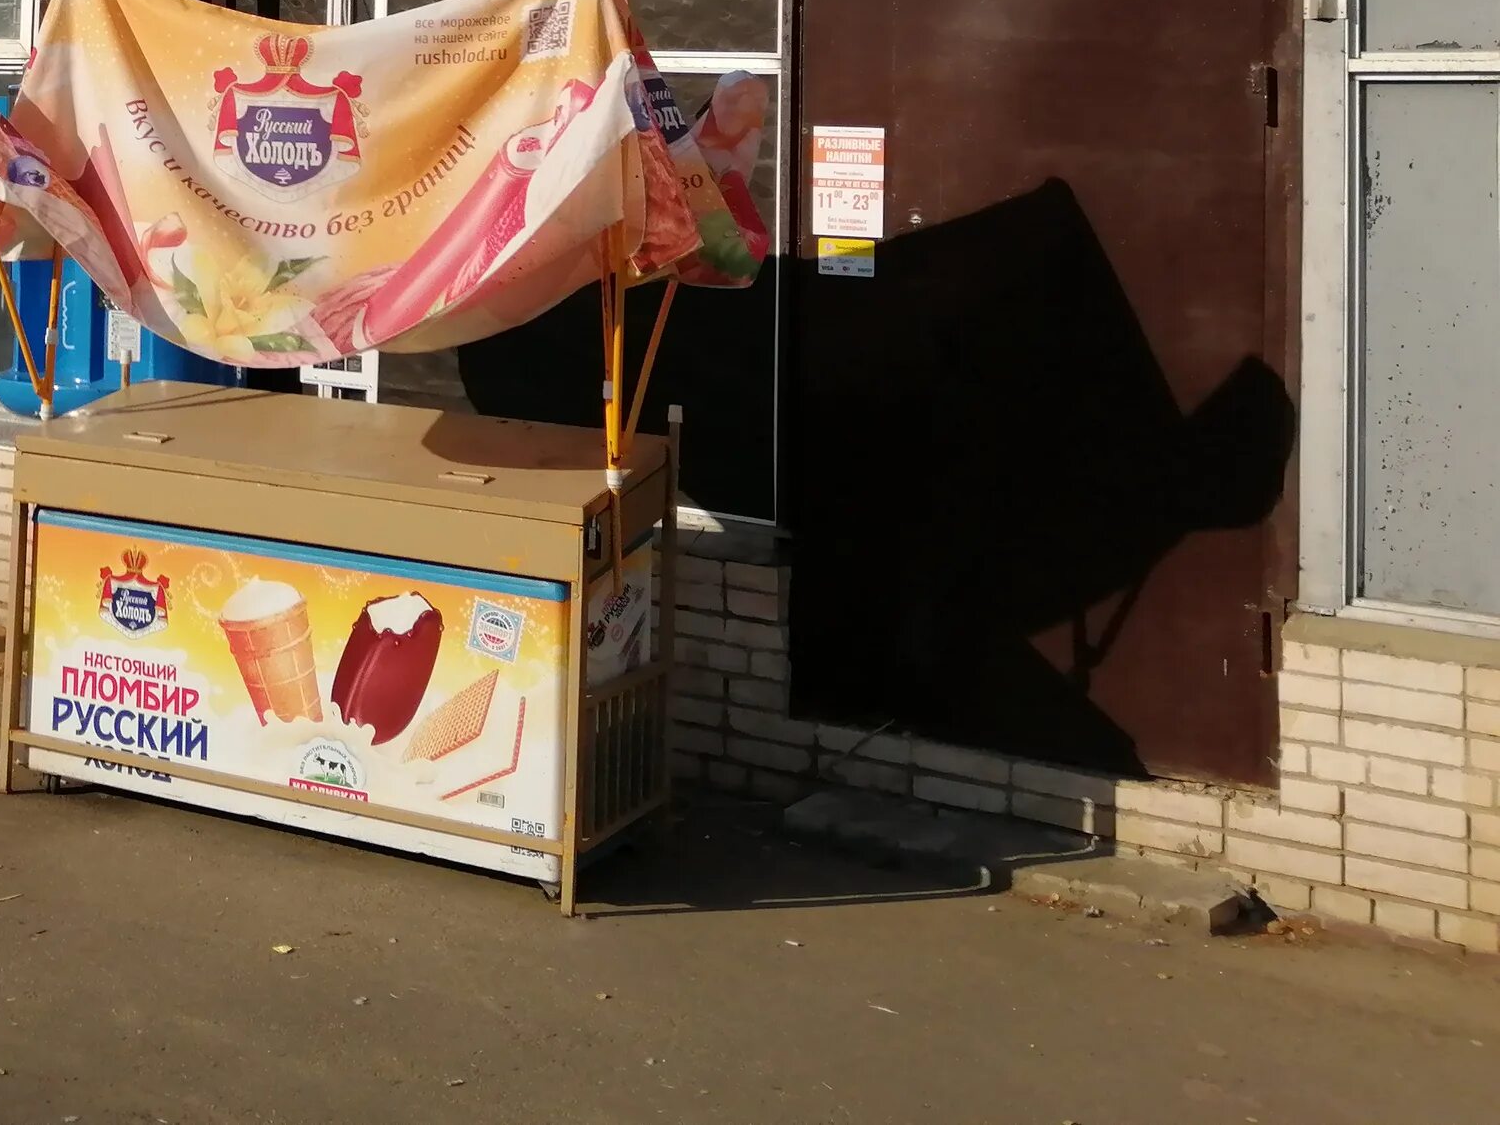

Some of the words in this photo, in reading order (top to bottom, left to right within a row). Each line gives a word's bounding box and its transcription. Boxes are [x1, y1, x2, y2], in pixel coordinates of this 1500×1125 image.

[415, 18, 435, 29] все
[441, 15, 511, 31] мороженое
[414, 35, 429, 44] на
[432, 34, 474, 43] нашем
[478, 28, 508, 42] сайте
[415, 46, 508, 66] rusholod.ru
[254, 108, 313, 140] Русский
[817, 137, 881, 151] РАЗЛИВНЫЕ
[826, 150, 872, 163] НАПИТКИ
[126, 99, 166, 153] Вкус
[164, 157, 182, 172] и
[181, 176, 316, 239] качество
[327, 208, 375, 236] без
[83, 651, 177, 682] НАСТОЯЩИЙ
[61, 666, 199, 717] ПЛОМБИР
[52, 696, 209, 762] РУССКИЙ
